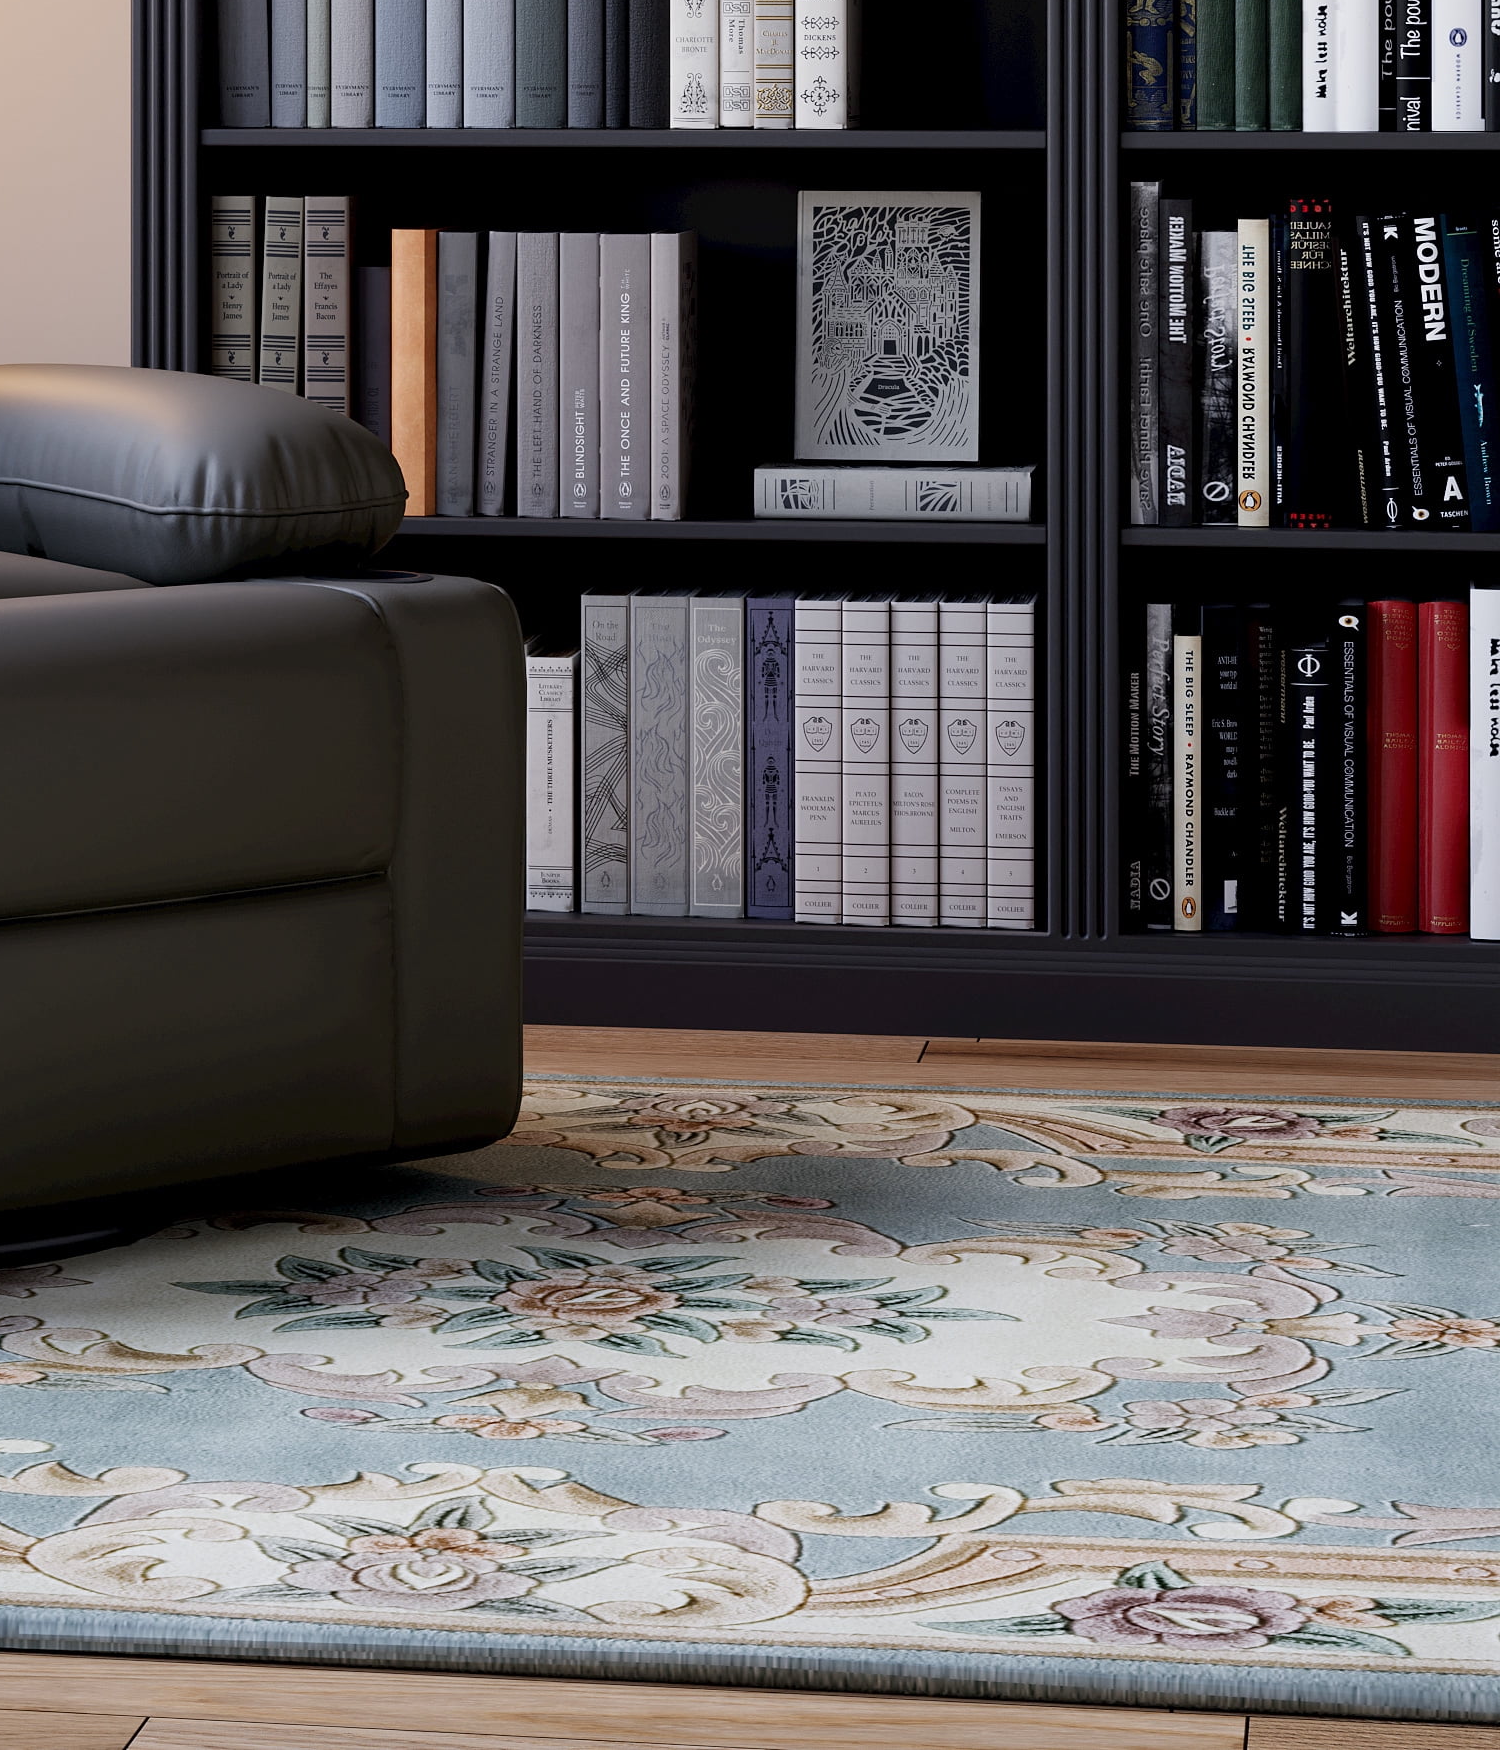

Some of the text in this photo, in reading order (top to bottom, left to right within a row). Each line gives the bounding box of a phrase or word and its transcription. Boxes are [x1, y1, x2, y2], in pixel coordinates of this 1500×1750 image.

[728, 19, 736, 43] More
[738, 18, 746, 55] Thomas
[804, 34, 837, 42] DICKENS
[1399, 29, 1421, 60] The
[216, 271, 250, 280] Portrait of
[1413, 217, 1449, 342] MODERN
[226, 281, 244, 292] Lady
[221, 300, 244, 312] Henry
[314, 302, 338, 310] Francis
[221, 311, 243, 321] James
[315, 312, 336, 321] Bacon
[620, 292, 630, 478] THE ONCE AND FUTURE KING
[574, 410, 585, 479] BLINDSIGHT
[1443, 475, 1464, 502] A
[1439, 510, 1469, 518] TASCHEN
[707, 623, 727, 633] The
[697, 633, 737, 646] Odyssey
[1128, 672, 1140, 777] THE MOTION MAKER
[1343, 641, 1355, 848] ESSENTIALS OF VISUAL COMMUNICATION
[1185, 650, 1194, 887] THE BIG SLEEP RAYMOND CHANDLER
